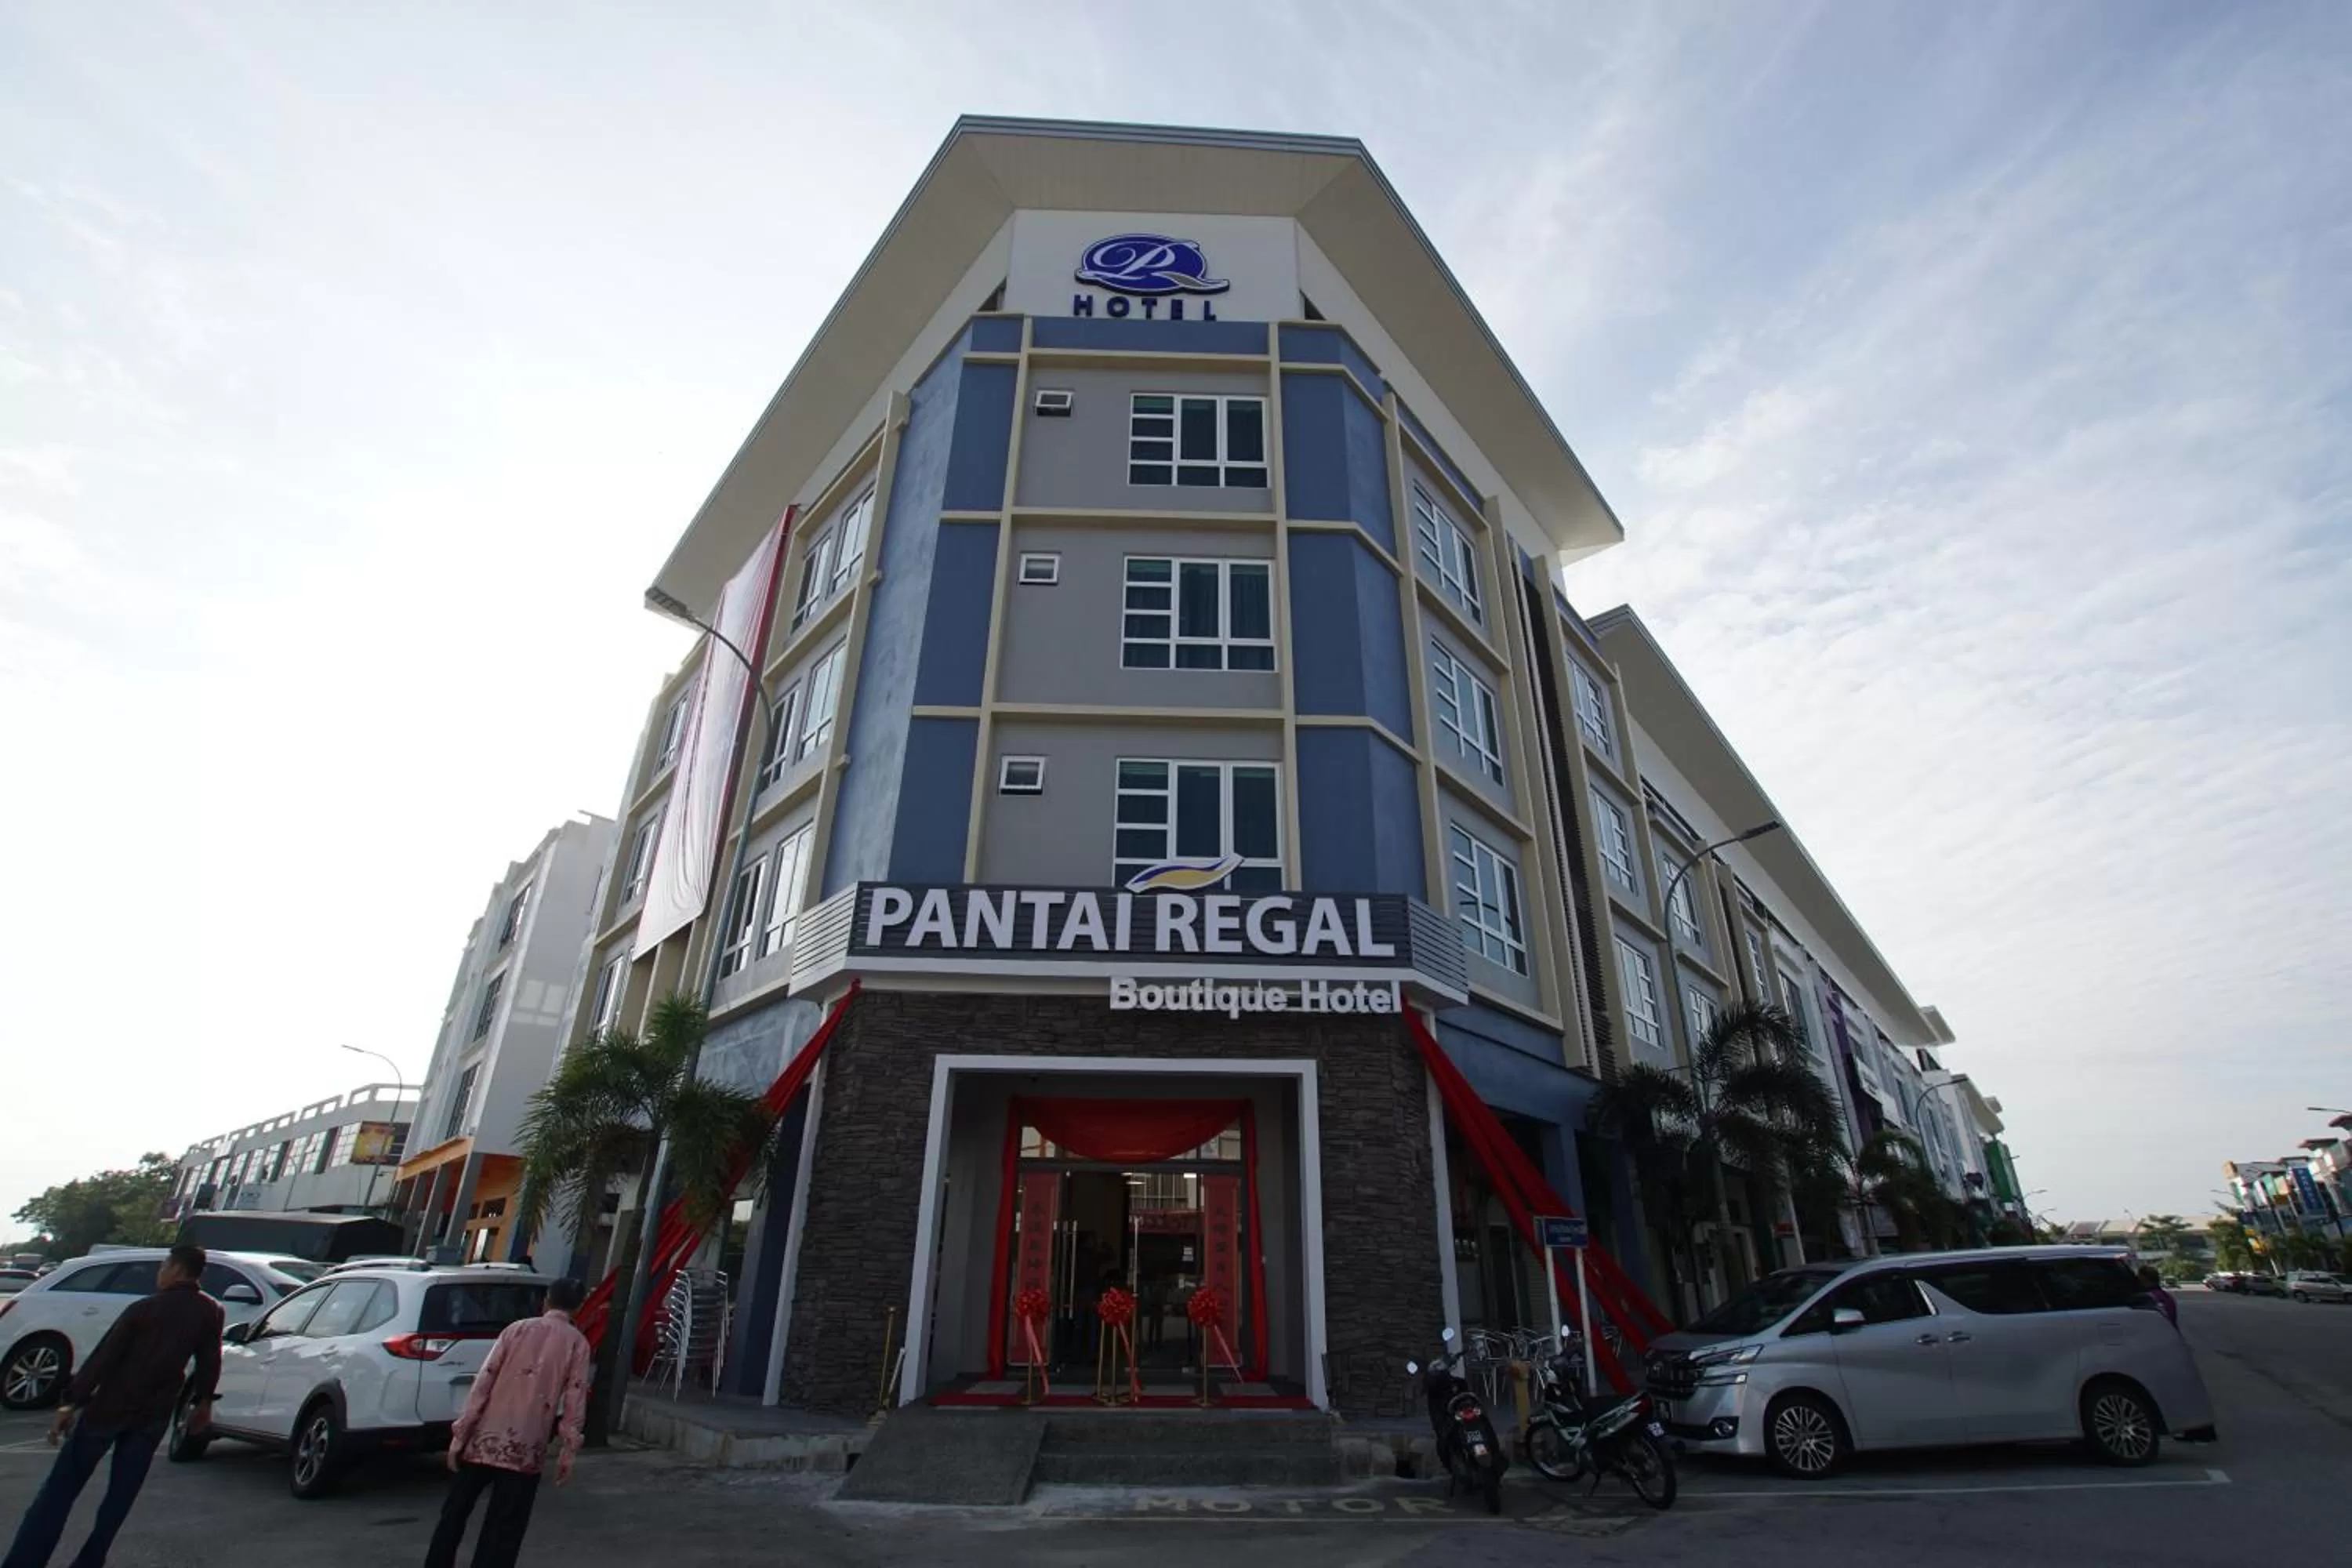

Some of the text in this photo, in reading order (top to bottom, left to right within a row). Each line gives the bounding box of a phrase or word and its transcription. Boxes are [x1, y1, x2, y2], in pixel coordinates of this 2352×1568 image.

[1073, 295, 1217, 321] HOTEL
[866, 887, 1395, 956] PANTAI REGAL
[1109, 976, 1402, 1019] Boutique Hotel
[1134, 1496, 1456, 1514] MOTOR
